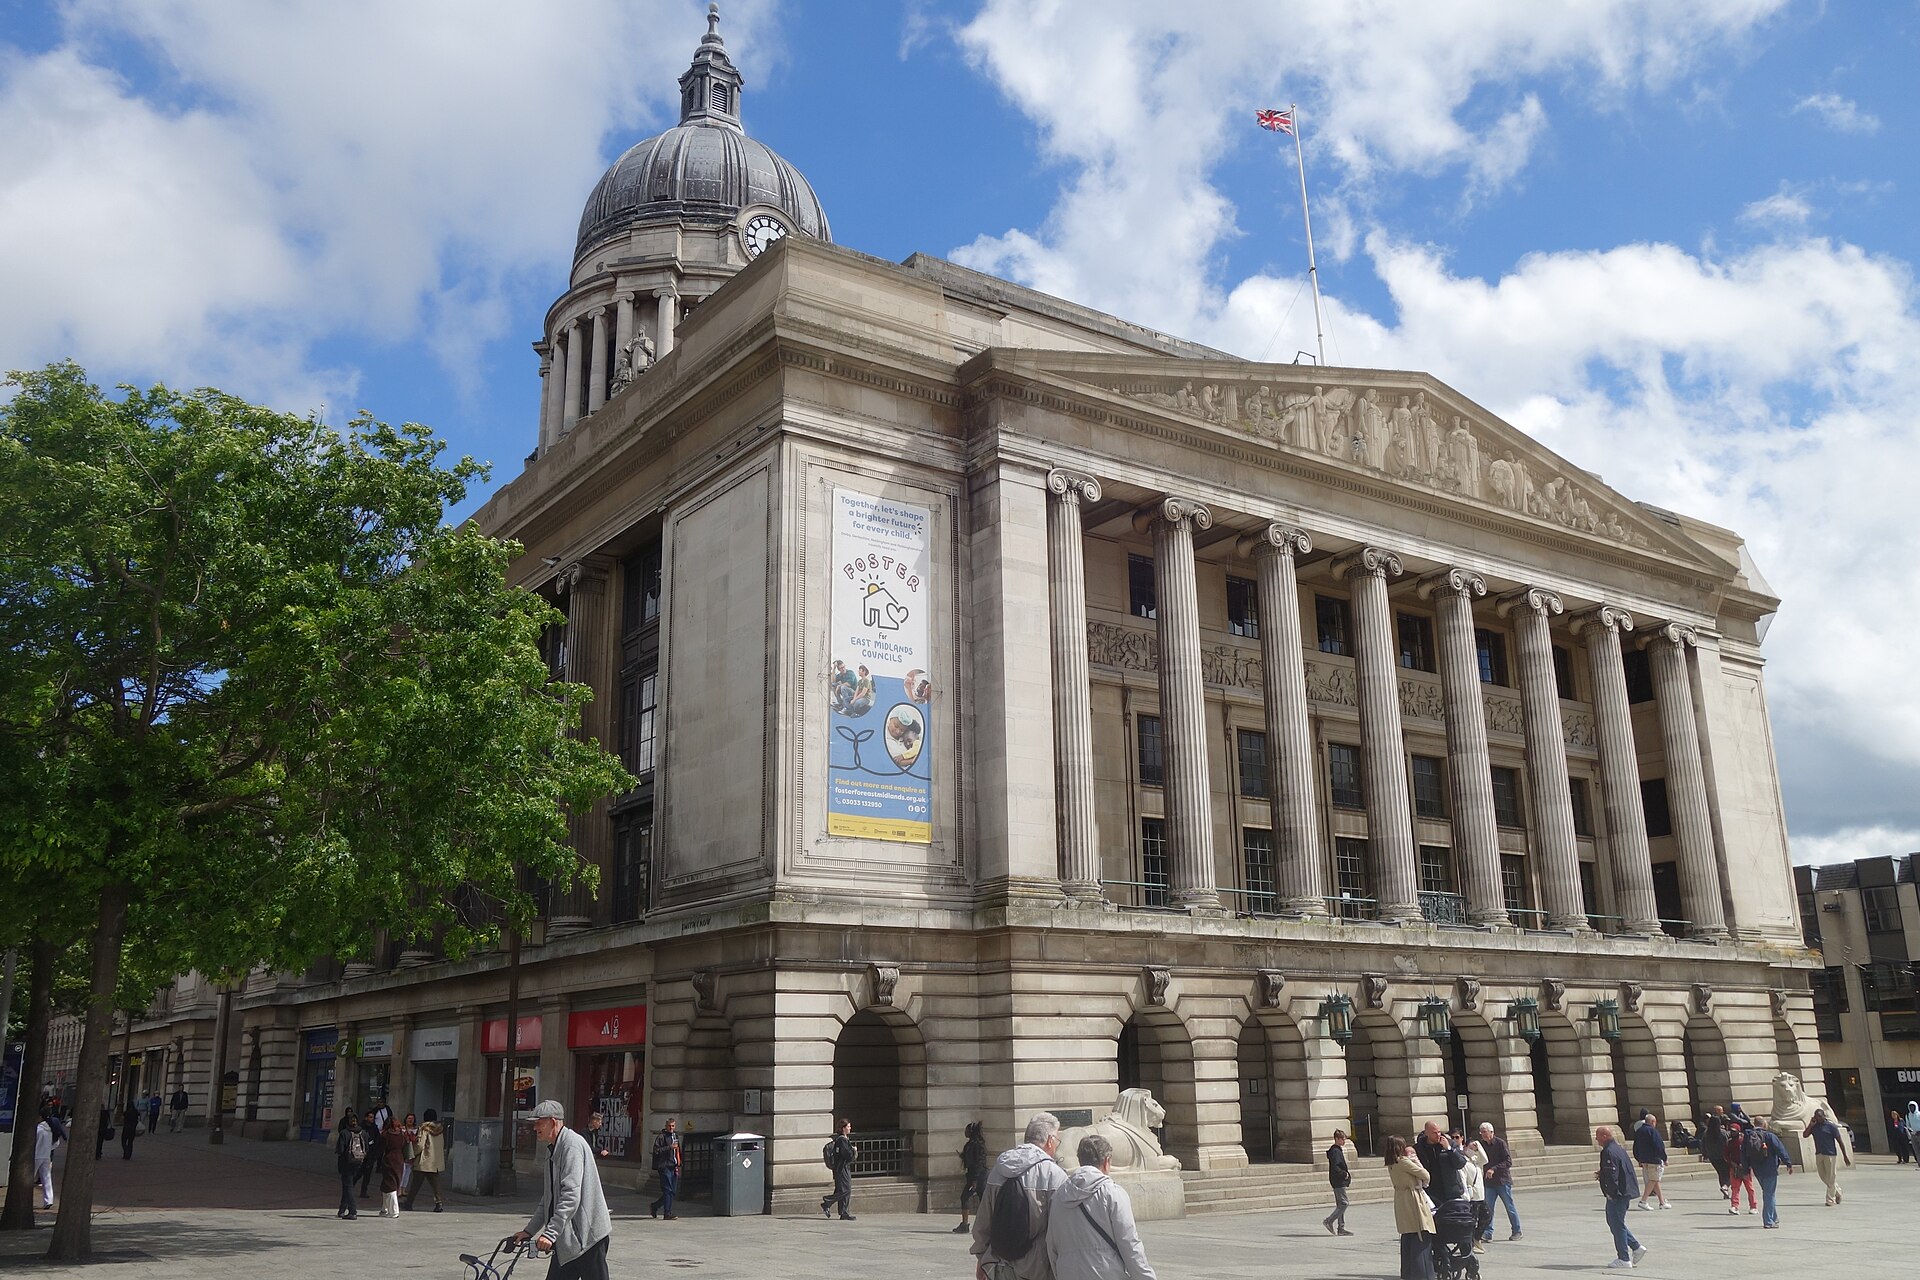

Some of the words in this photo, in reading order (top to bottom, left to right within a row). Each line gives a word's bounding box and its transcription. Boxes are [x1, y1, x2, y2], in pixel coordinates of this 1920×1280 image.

[841, 496, 880, 512] Together,
[881, 505, 898, 515] let's
[900, 510, 924, 521] shape
[856, 510, 889, 524] brighter
[891, 518, 917, 530] future
[852, 521, 865, 529] for
[866, 524, 889, 536] every
[891, 530, 912, 540] child.
[843, 553, 920, 592] FOSTER
[851, 637, 871, 647] EAST
[874, 640, 913, 656] MIDLANDS
[862, 649, 903, 663] COUNCILS
[835, 787, 926, 803] fosterforeastmidlands.org.uk
[894, 785, 918, 793] enquire
[600, 1097, 621, 1117] END
[597, 1116, 632, 1138] SEASON
[597, 1136, 626, 1157] SALE
